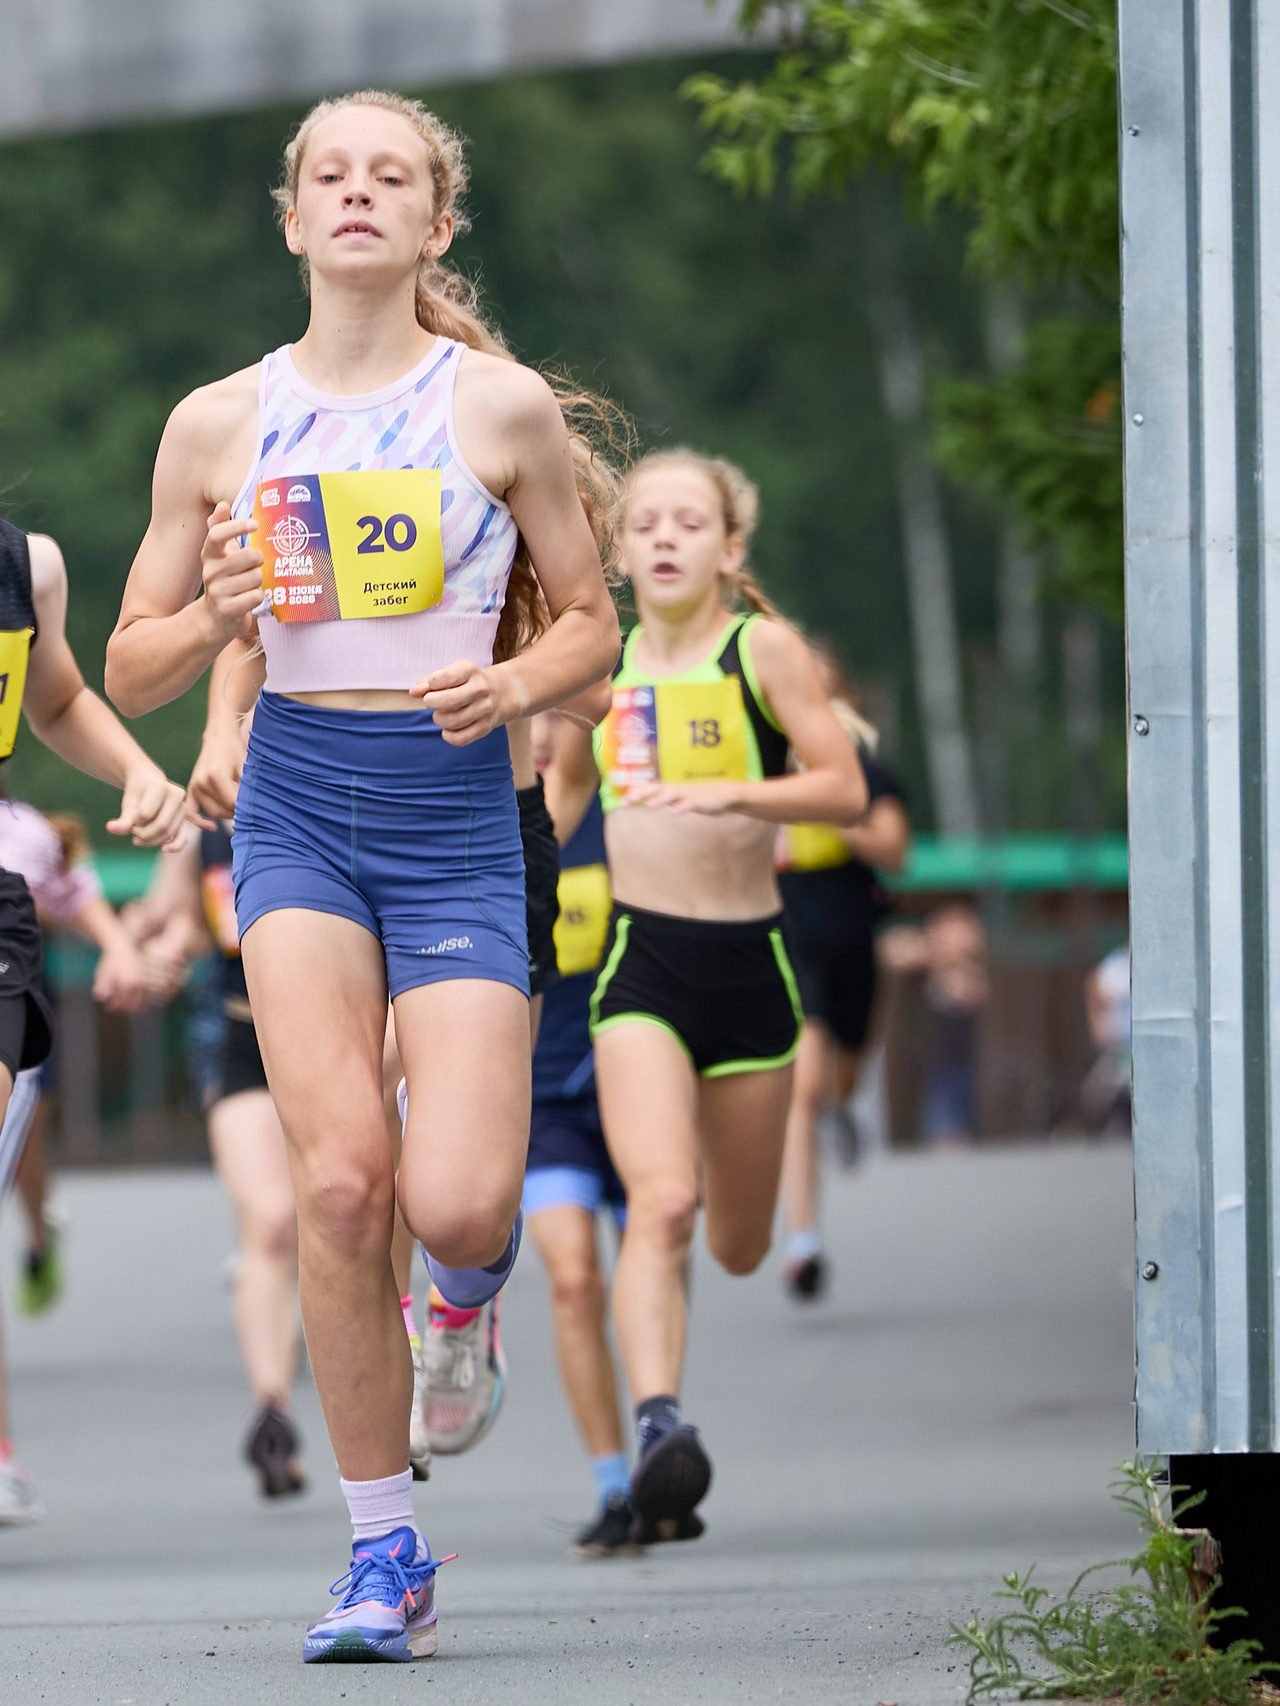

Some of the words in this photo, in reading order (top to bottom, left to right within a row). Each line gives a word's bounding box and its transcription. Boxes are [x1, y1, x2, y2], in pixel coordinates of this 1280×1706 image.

[356, 513, 417, 554] 20
[274, 555, 313, 569] АРЕНА
[274, 567, 314, 578] БИАТЛОНА
[289, 585, 323, 595] ИЮНЯ
[363, 578, 417, 593] Детский
[373, 595, 408, 606] забег
[688, 719, 721, 748] 18
